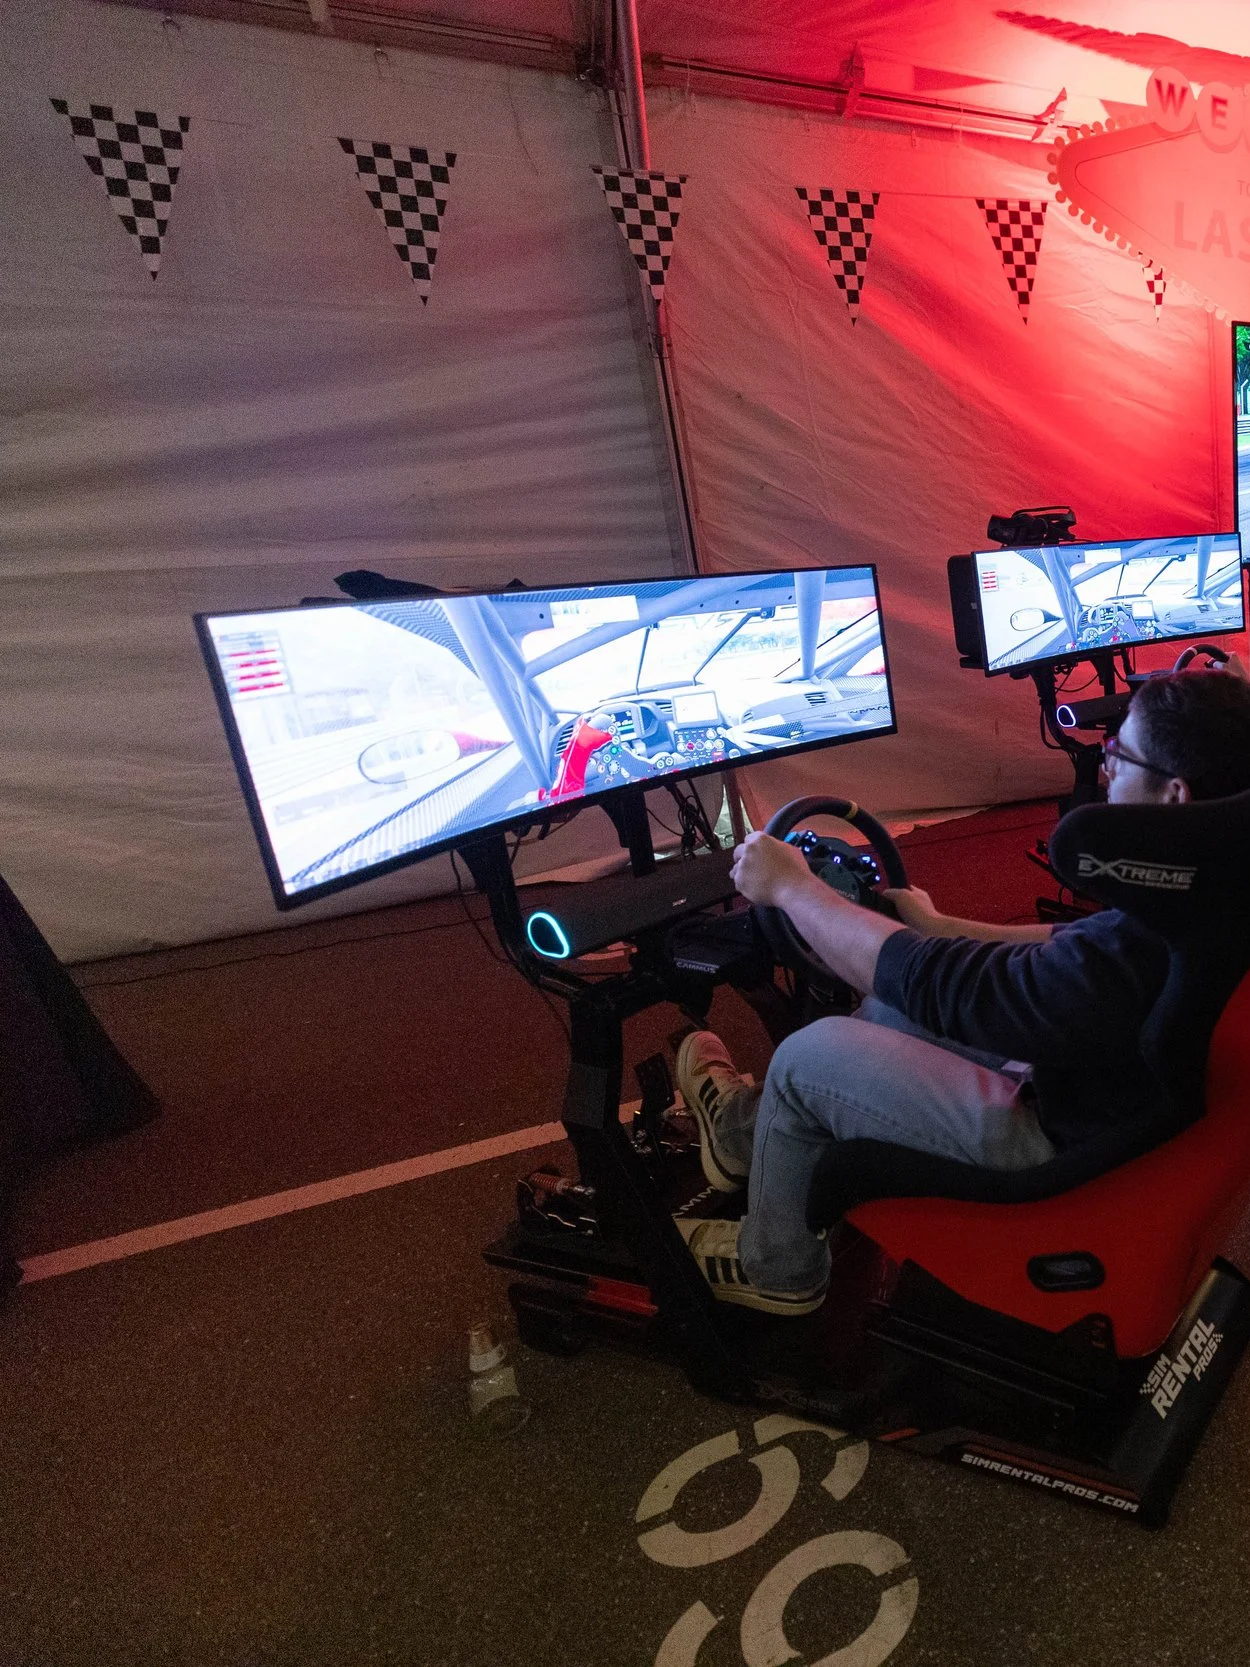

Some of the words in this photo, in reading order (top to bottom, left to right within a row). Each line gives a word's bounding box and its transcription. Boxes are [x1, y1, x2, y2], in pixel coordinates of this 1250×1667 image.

[1147, 1352, 1172, 1389] SIM
[1151, 1318, 1215, 1419] RENTAL
[1192, 1336, 1218, 1381] PROS
[961, 1453, 1140, 1513] SIMRENTALPROS.COM
